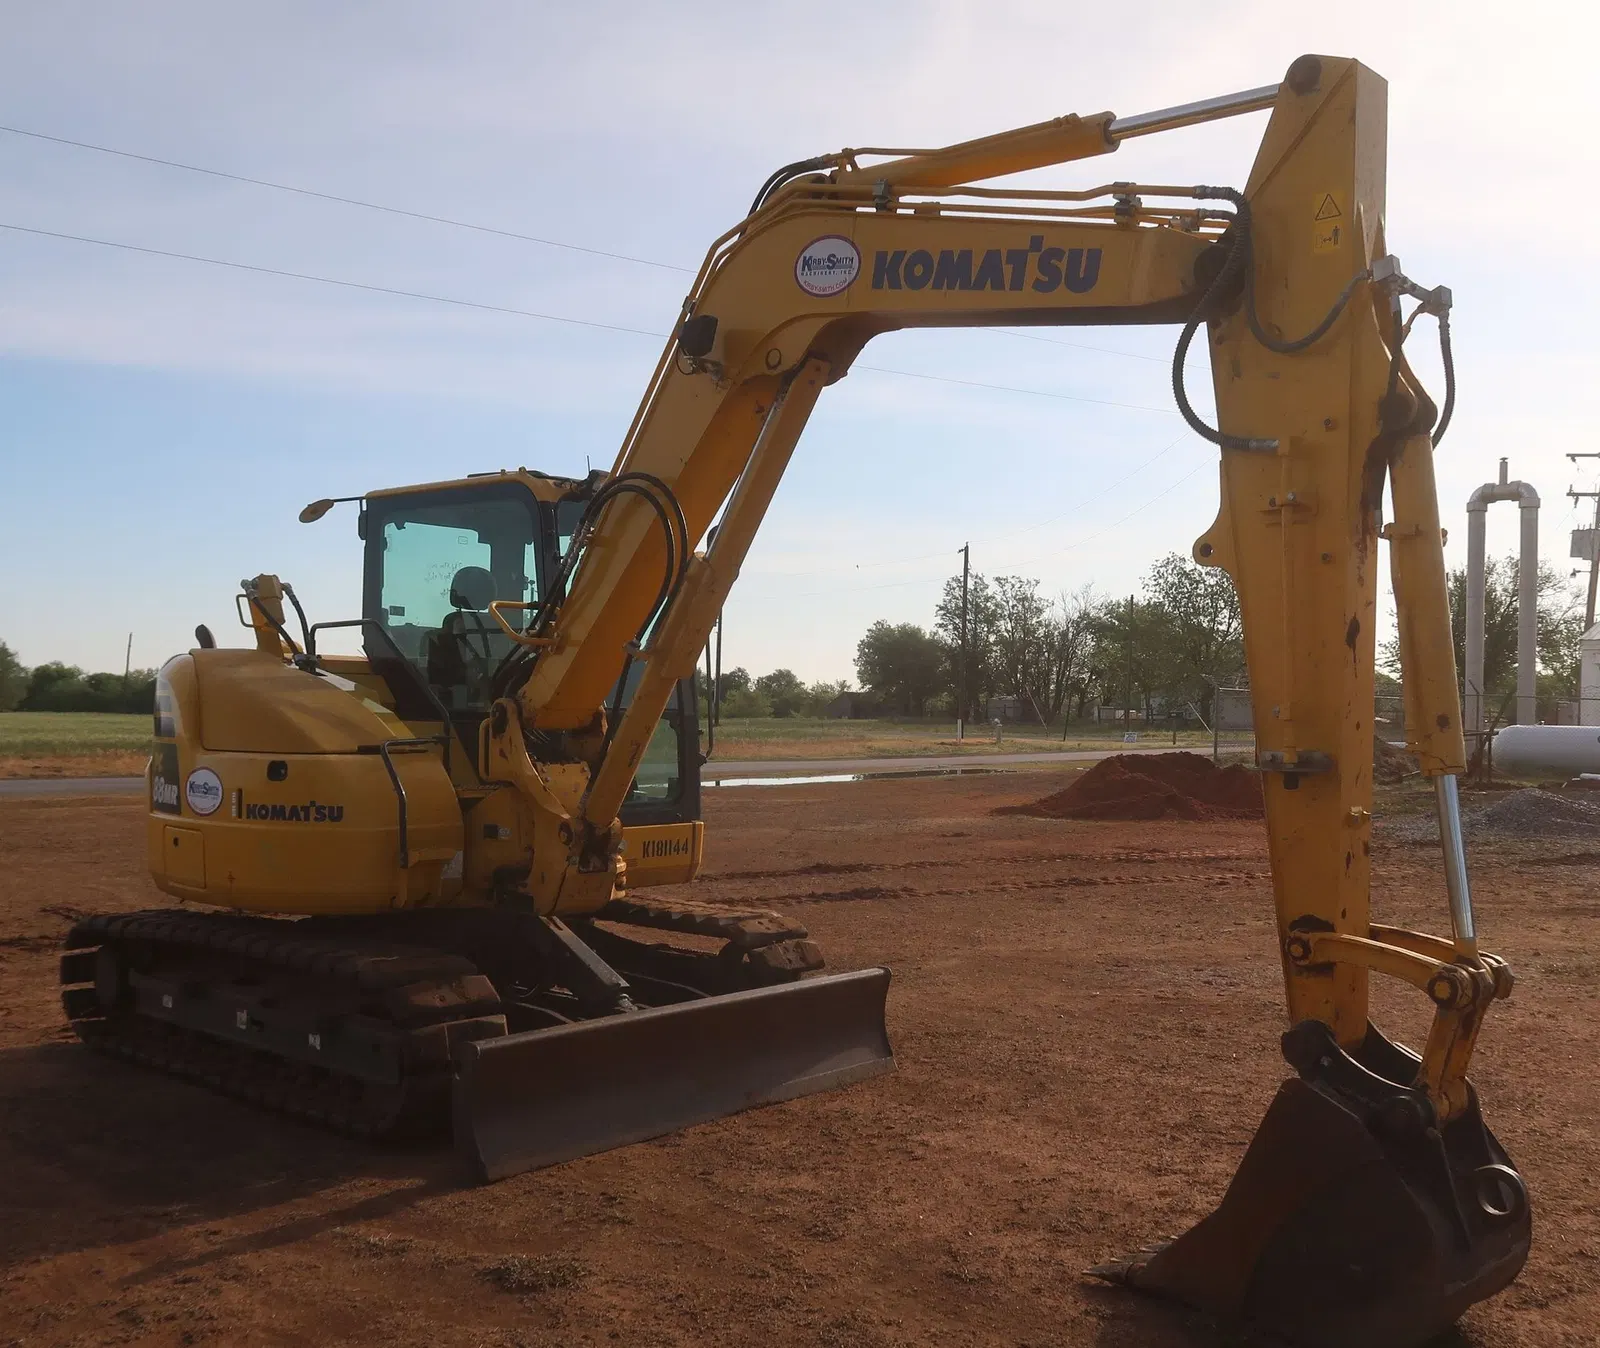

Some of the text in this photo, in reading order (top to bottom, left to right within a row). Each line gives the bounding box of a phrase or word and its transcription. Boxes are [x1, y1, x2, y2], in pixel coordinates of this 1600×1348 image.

[872, 235, 1102, 293] KOMATSU
[247, 801, 343, 822] KOMATSU
[643, 837, 688, 858] K181144
